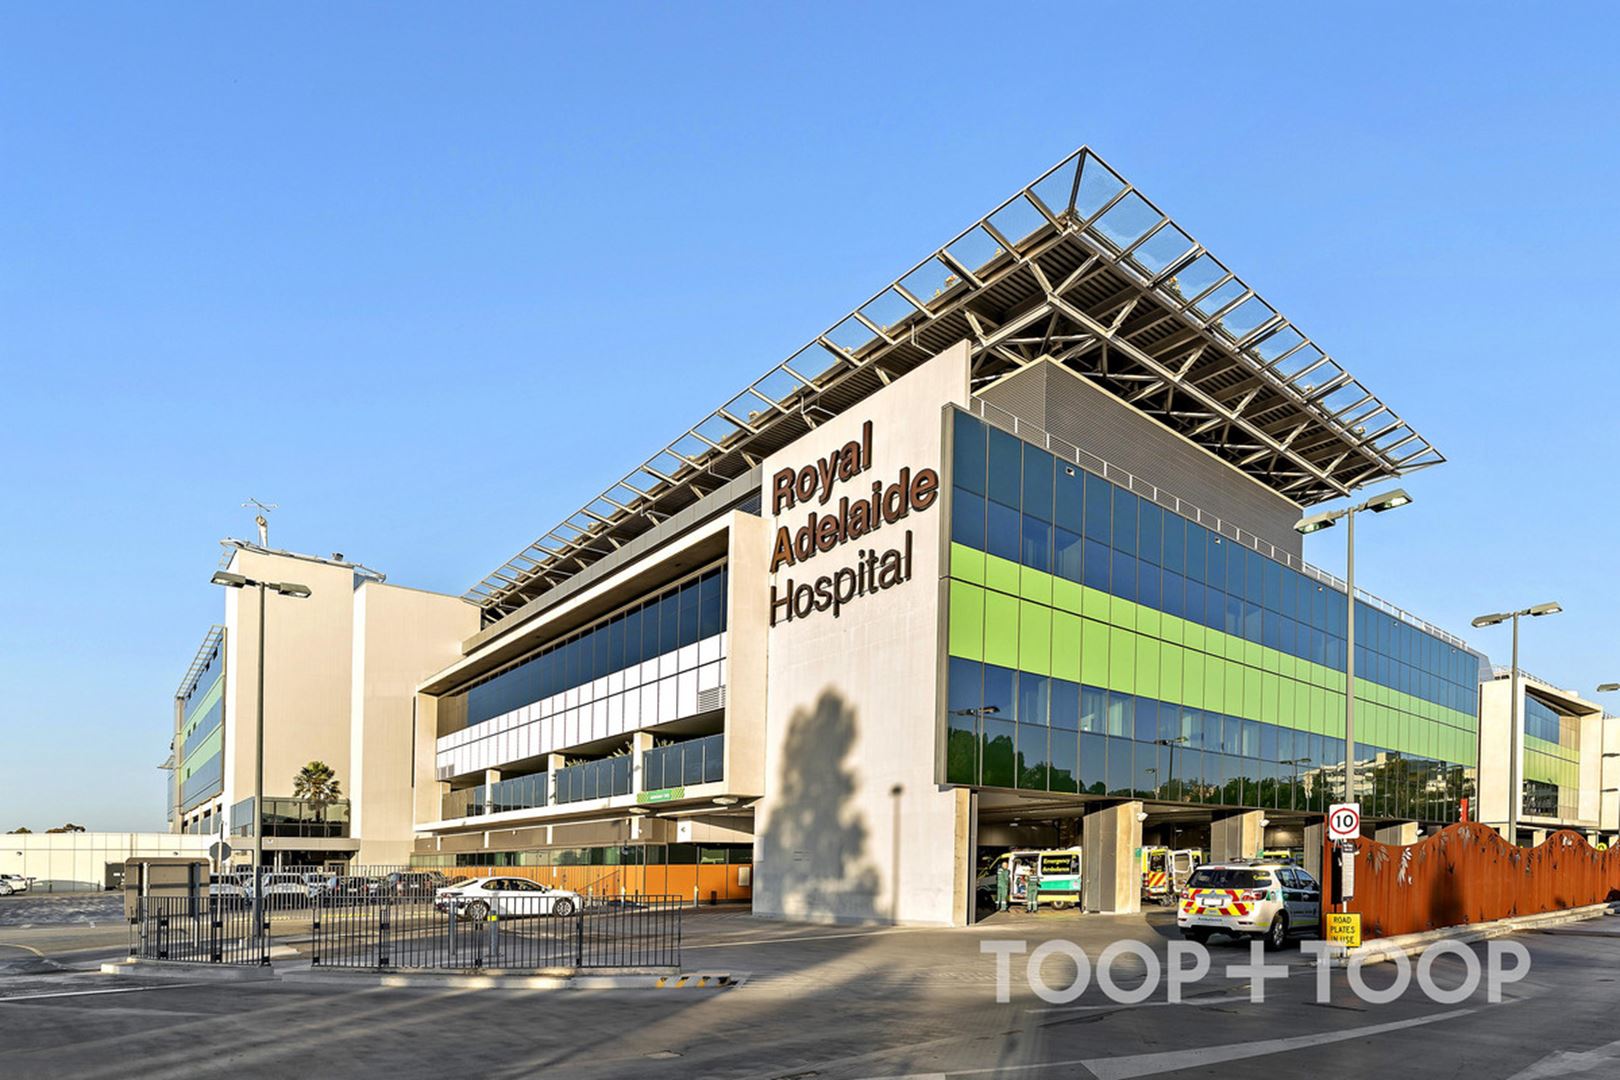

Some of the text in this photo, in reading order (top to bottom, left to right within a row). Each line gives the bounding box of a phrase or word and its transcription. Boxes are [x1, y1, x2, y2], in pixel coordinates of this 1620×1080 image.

[772, 420, 873, 516] Royal
[770, 466, 939, 574] Adelaide
[770, 530, 912, 628] Hospital
[1336, 814, 1354, 828] 10
[1330, 926, 1355, 934] PLATES
[1333, 916, 1352, 924] ROAD
